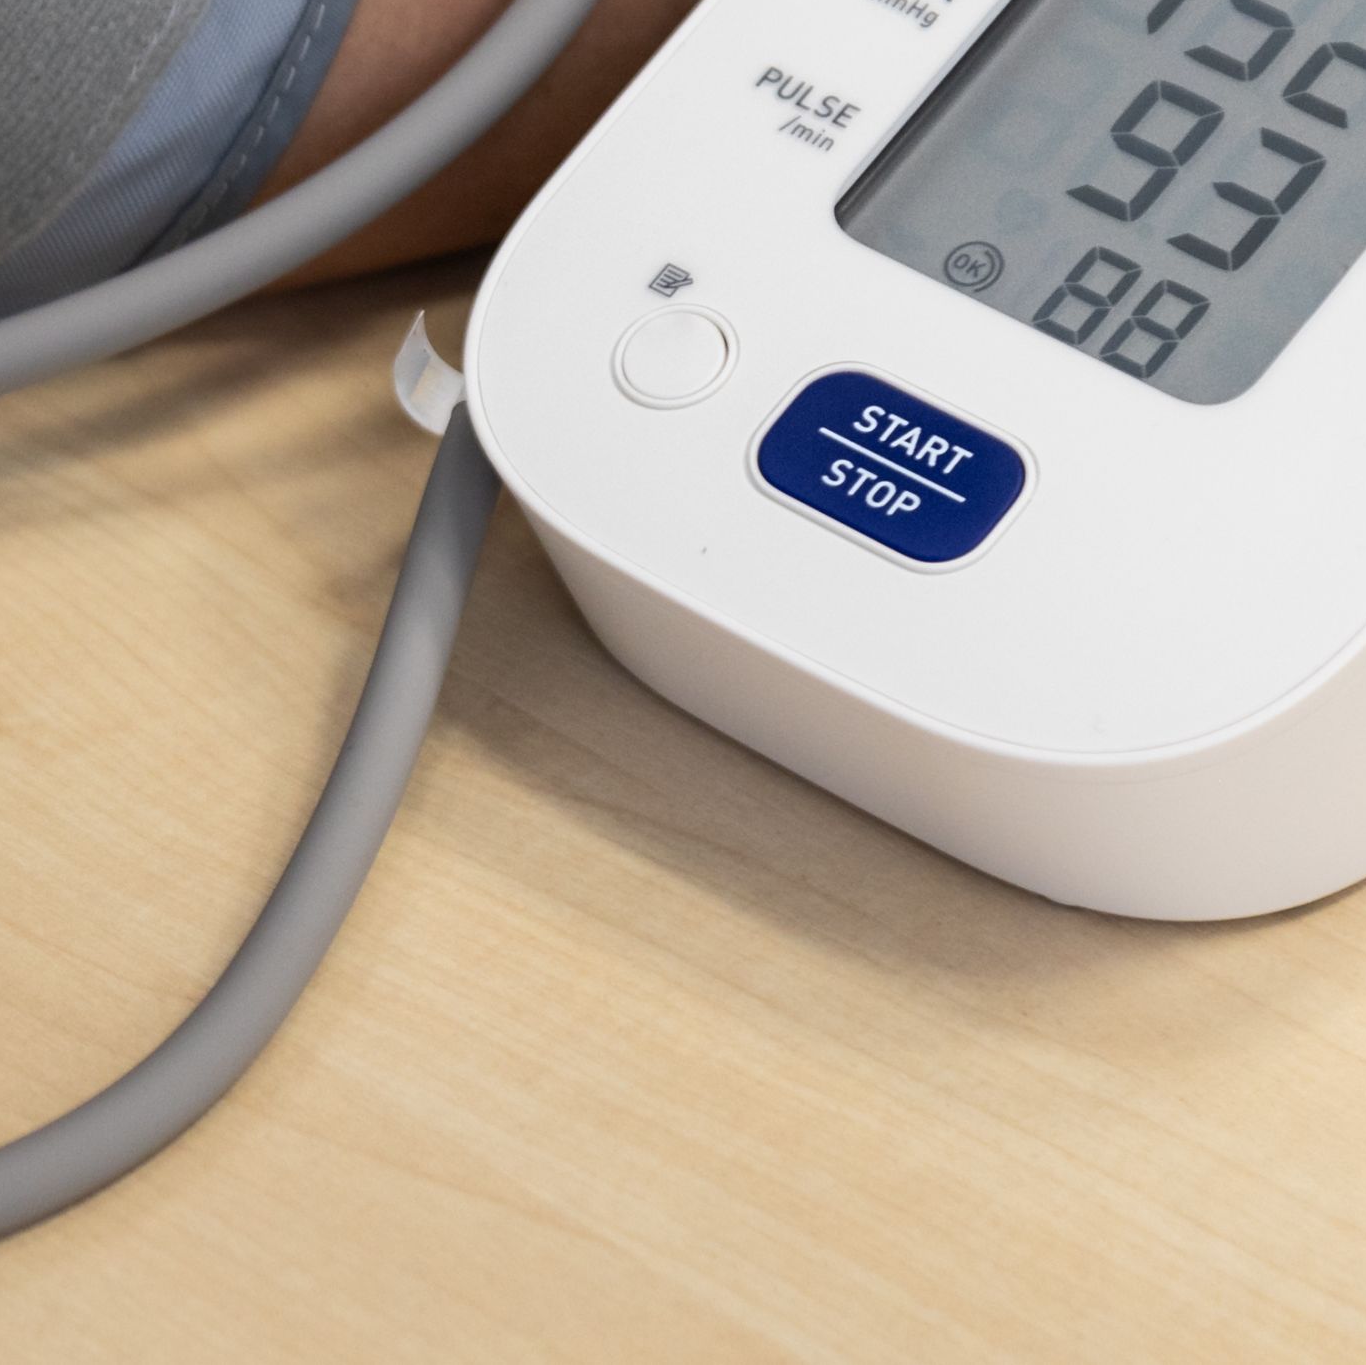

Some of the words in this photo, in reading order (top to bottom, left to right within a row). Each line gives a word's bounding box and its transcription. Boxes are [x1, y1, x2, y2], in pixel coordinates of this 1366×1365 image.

[755, 66, 861, 129] PULSE
[779, 116, 836, 152] /min
[1065, 80, 1327, 271] 93
[952, 252, 987, 279] OK
[1033, 245, 1210, 378] 88
[852, 405, 974, 475] START
[821, 459, 922, 517] STOP
